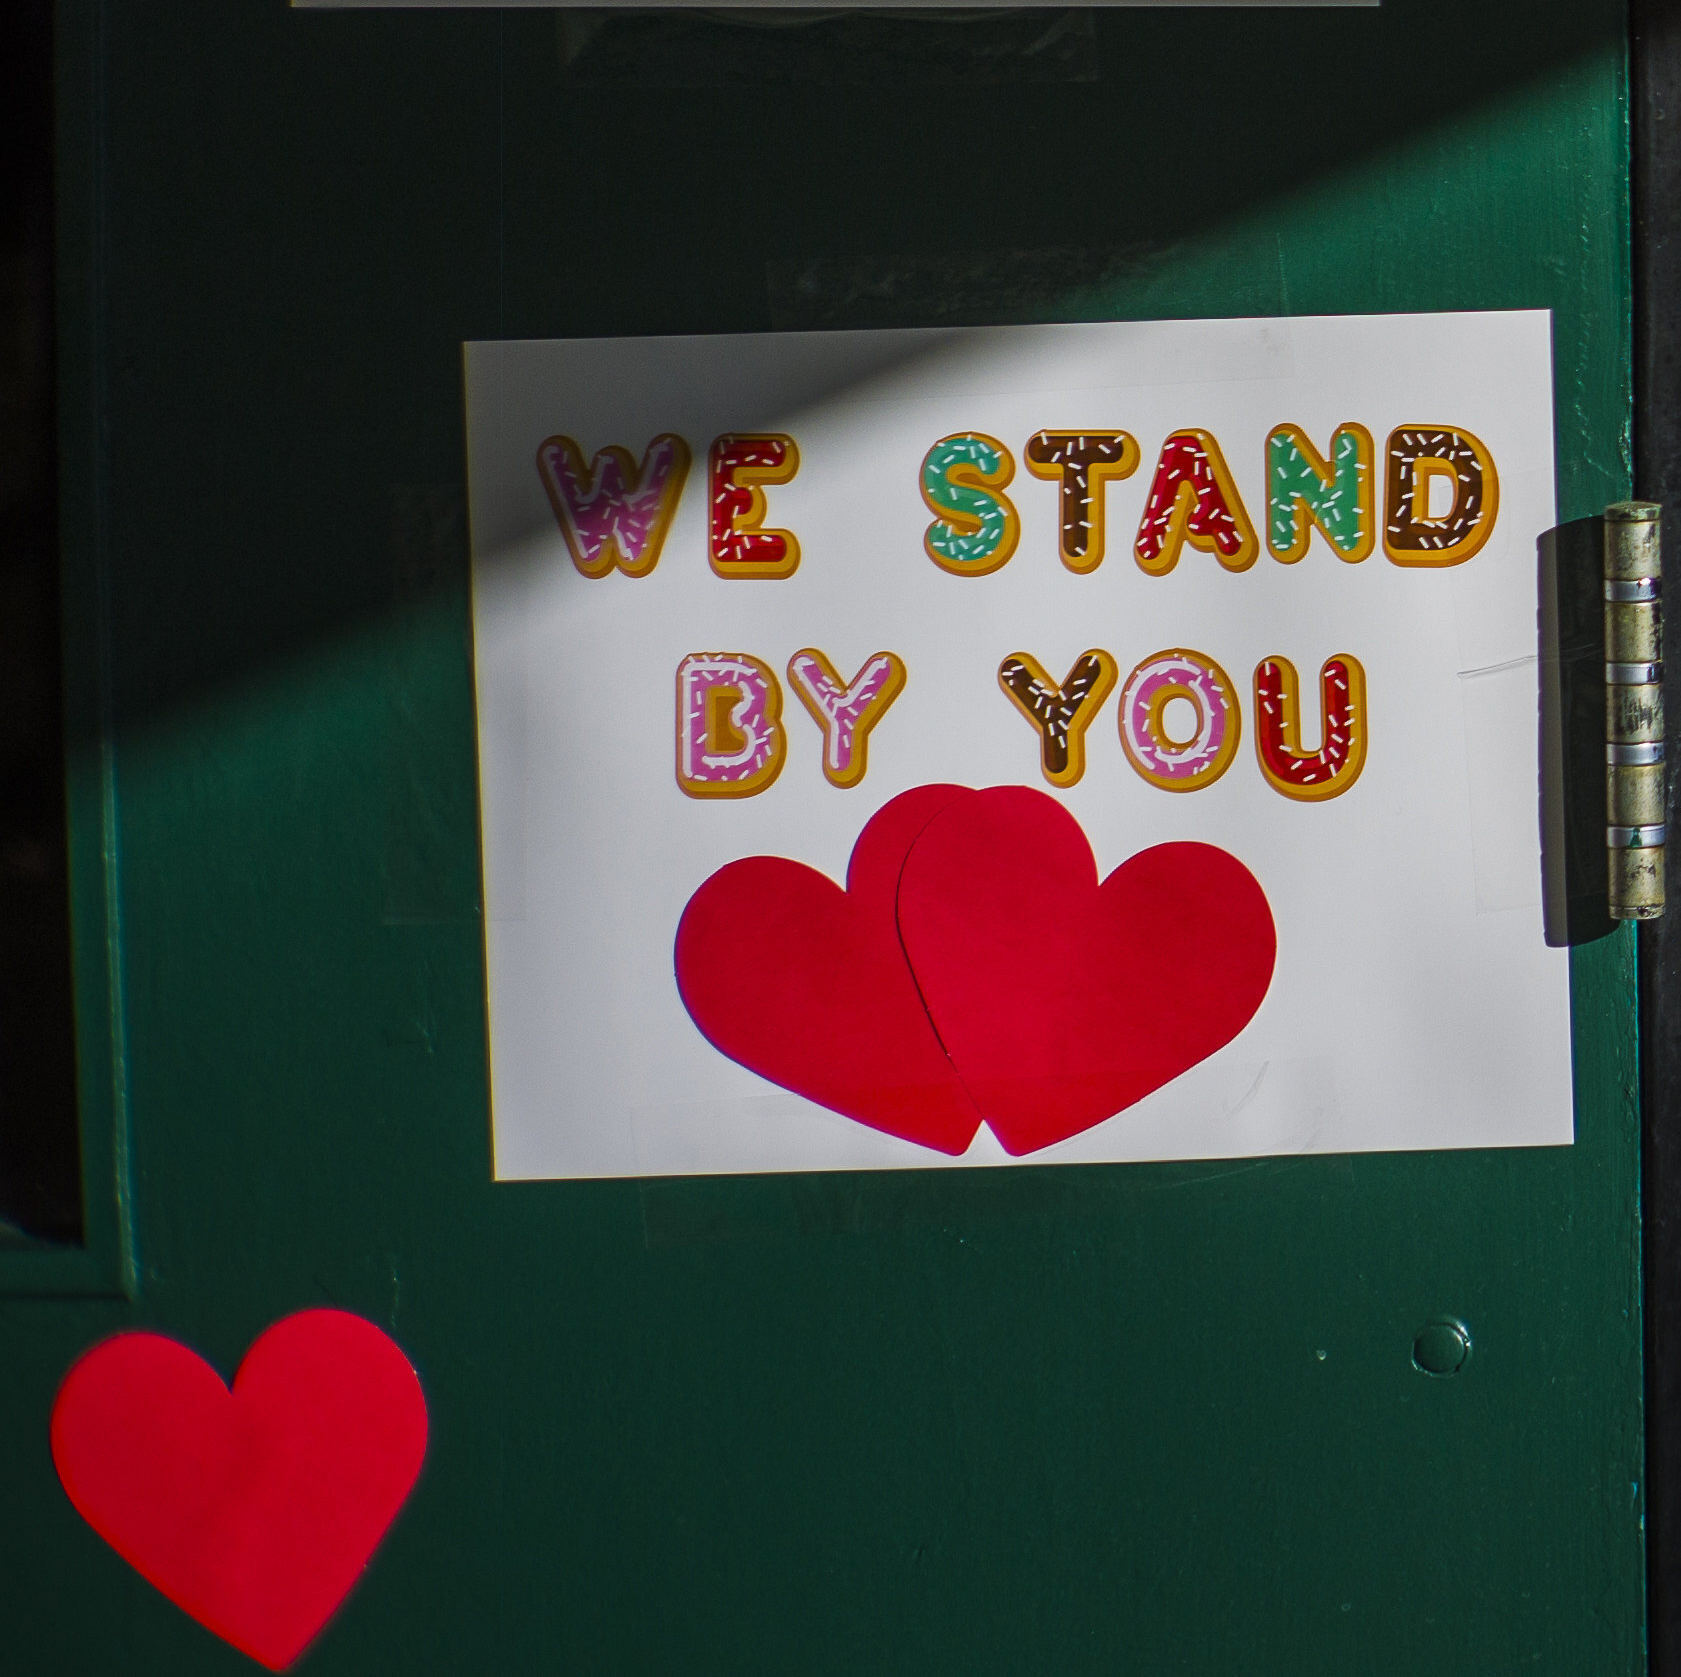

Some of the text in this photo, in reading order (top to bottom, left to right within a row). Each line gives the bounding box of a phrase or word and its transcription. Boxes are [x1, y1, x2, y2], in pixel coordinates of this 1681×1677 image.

[535, 422, 1499, 580] WE STAND
[674, 648, 1368, 802] BY YOU
